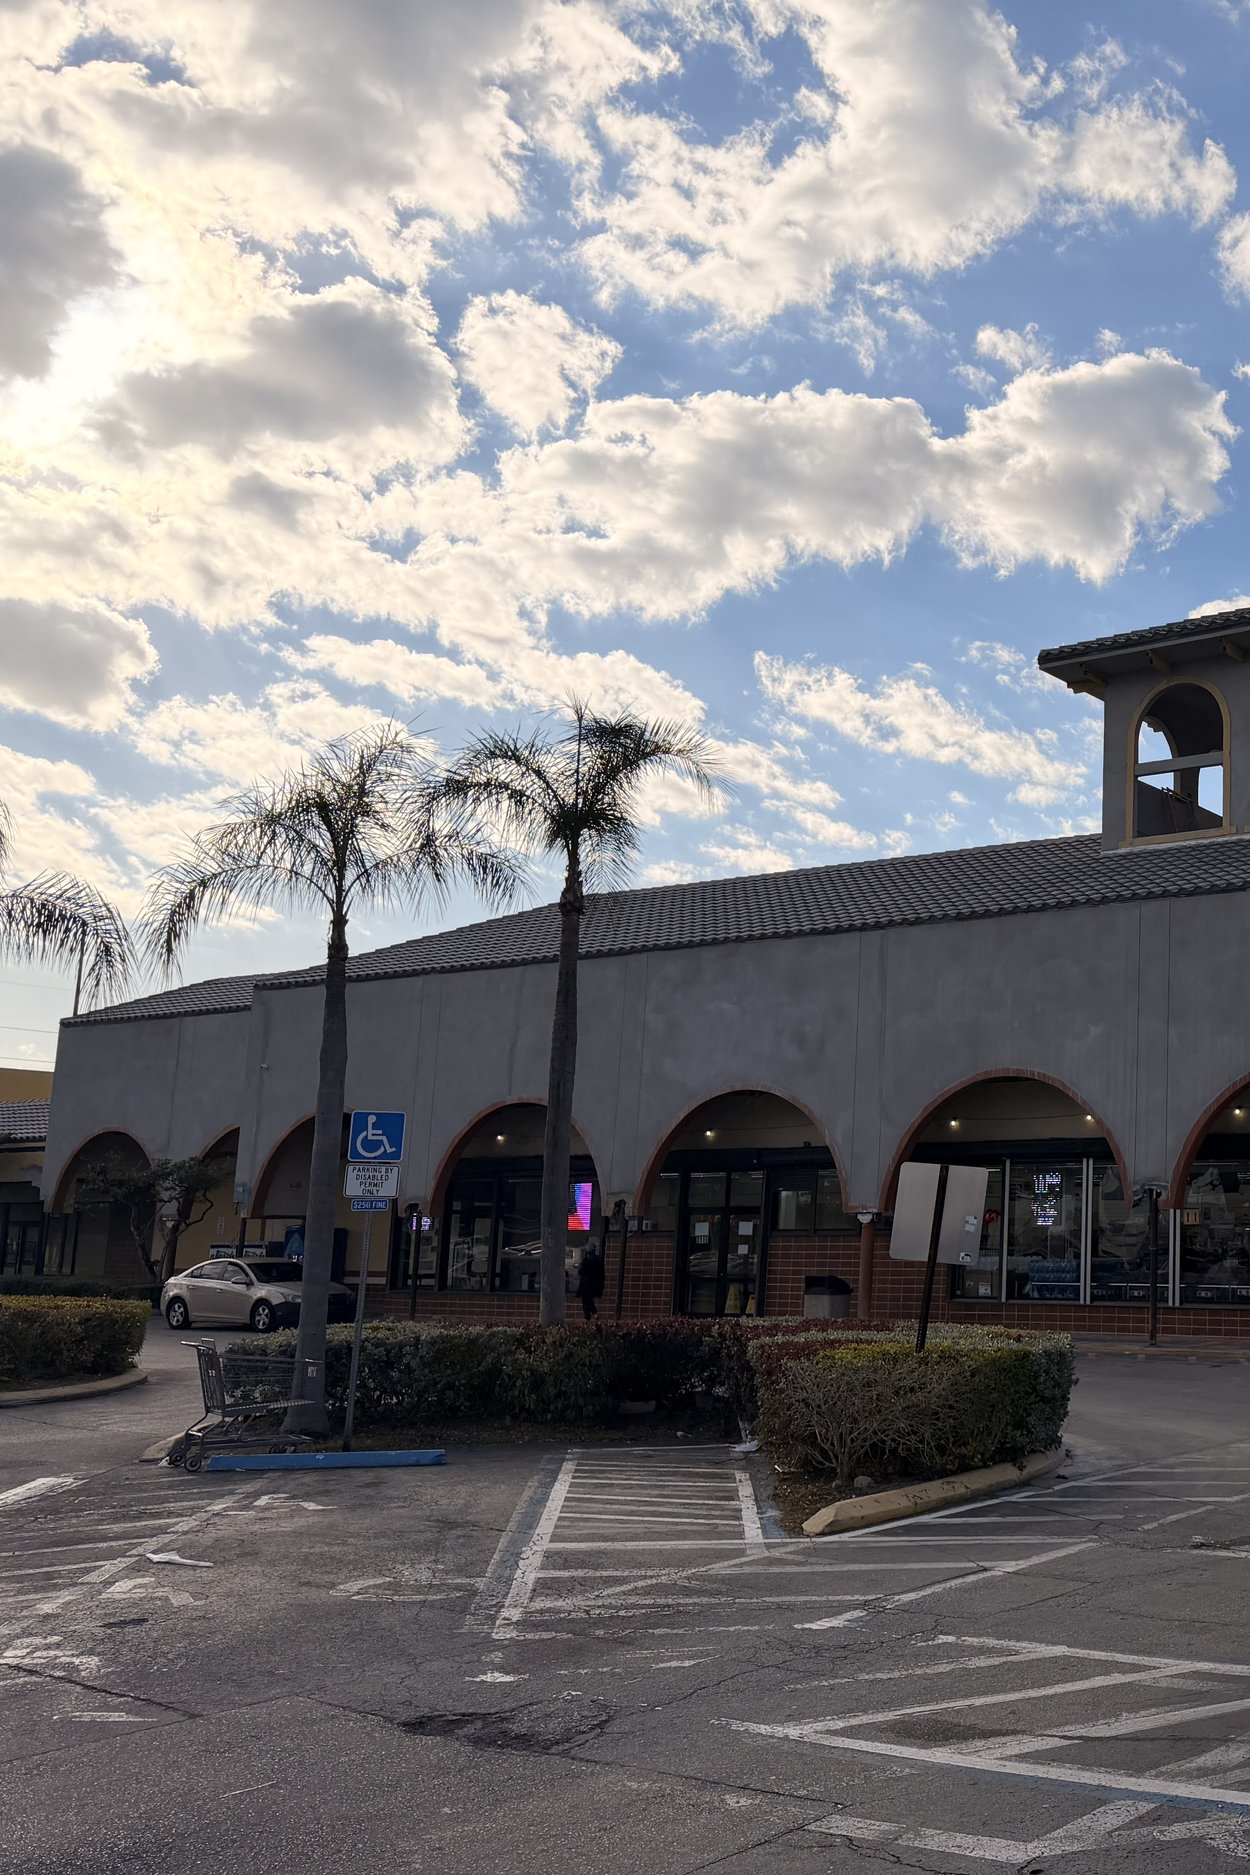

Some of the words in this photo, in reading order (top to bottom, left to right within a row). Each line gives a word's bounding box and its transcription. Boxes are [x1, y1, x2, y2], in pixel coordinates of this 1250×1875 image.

[352, 1166, 383, 1174] PARKING
[384, 1167, 394, 1175] BY
[361, 1188, 380, 1196] ONLY
[353, 1201, 371, 1209] $250
[372, 1201, 387, 1209] FINE
